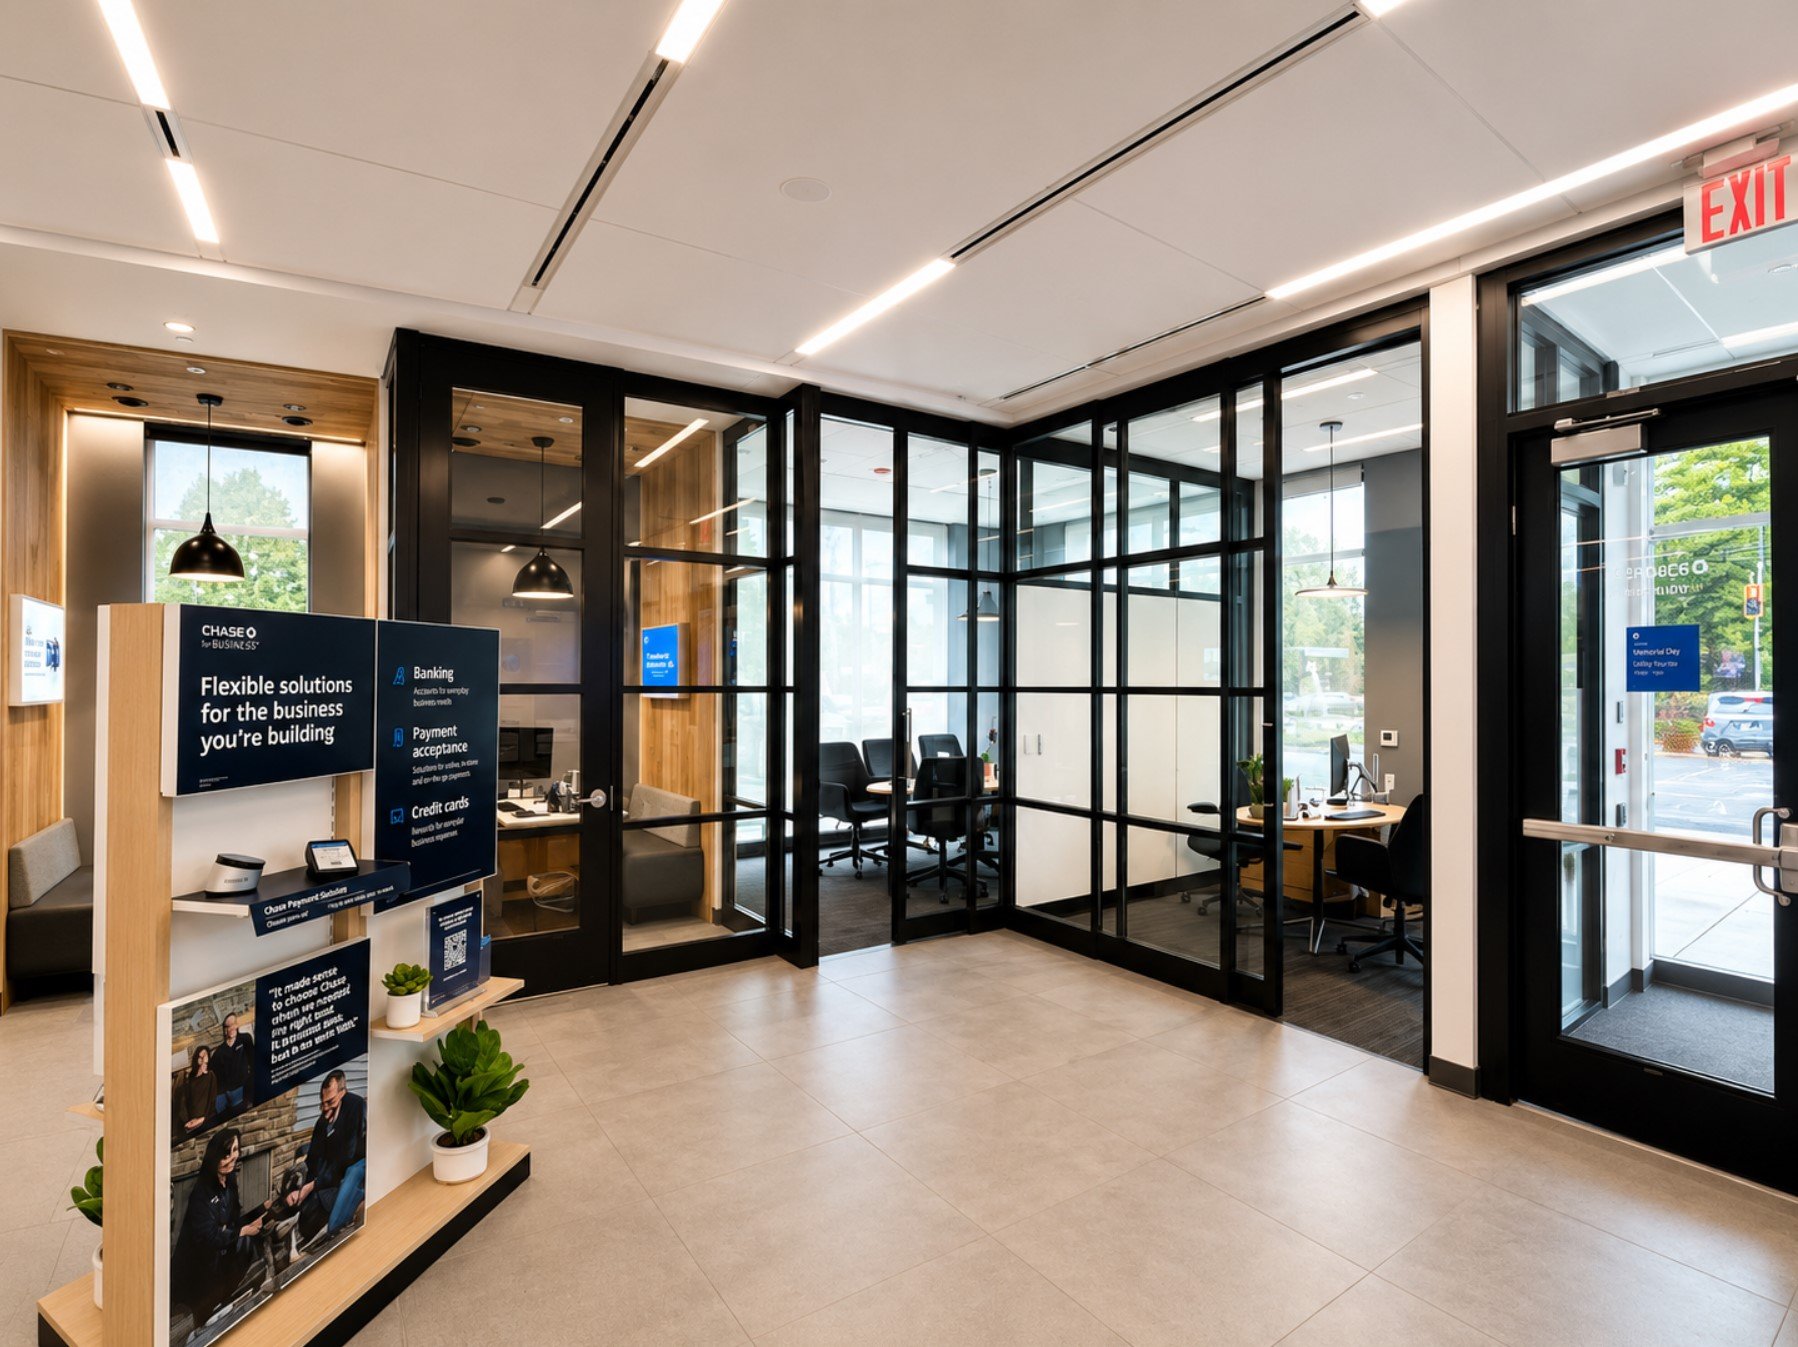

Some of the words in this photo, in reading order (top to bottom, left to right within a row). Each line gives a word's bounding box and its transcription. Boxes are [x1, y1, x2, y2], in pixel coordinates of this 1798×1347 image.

[1702, 155, 1790, 243] EXIT
[202, 624, 244, 638] CHASE
[414, 666, 454, 682] Banking
[201, 676, 274, 696] Flexible
[279, 676, 353, 695] solutions
[200, 703, 231, 723] for
[236, 702, 268, 722] the
[274, 700, 343, 720] business
[268, 724, 335, 745] building
[413, 725, 458, 742] Payment
[412, 742, 468, 759] acceptance
[412, 802, 442, 819] Credit
[444, 796, 470, 813] cards
[284, 977, 311, 994] made
[272, 1001, 282, 1012] to
